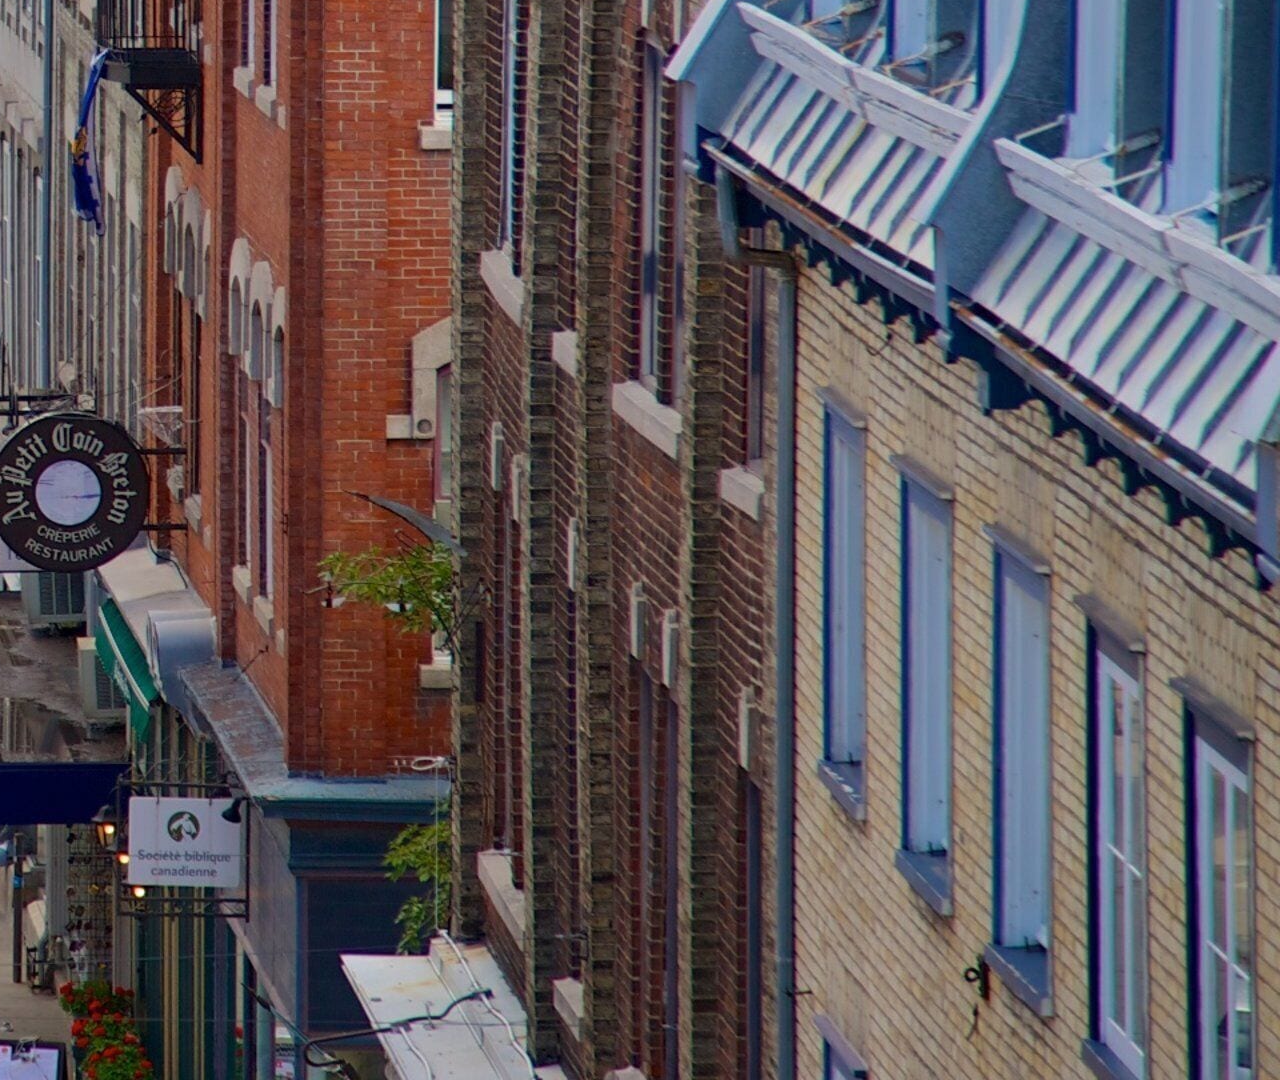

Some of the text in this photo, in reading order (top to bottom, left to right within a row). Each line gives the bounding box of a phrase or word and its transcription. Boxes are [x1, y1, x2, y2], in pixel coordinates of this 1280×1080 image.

[2, 490, 37, 525] Au
[51, 423, 105, 457] Coin
[96, 452, 138, 525] Breton
[24, 537, 115, 562] RESTAURANT
[137, 850, 231, 865] Société biblique
[151, 867, 218, 877] canadienne
